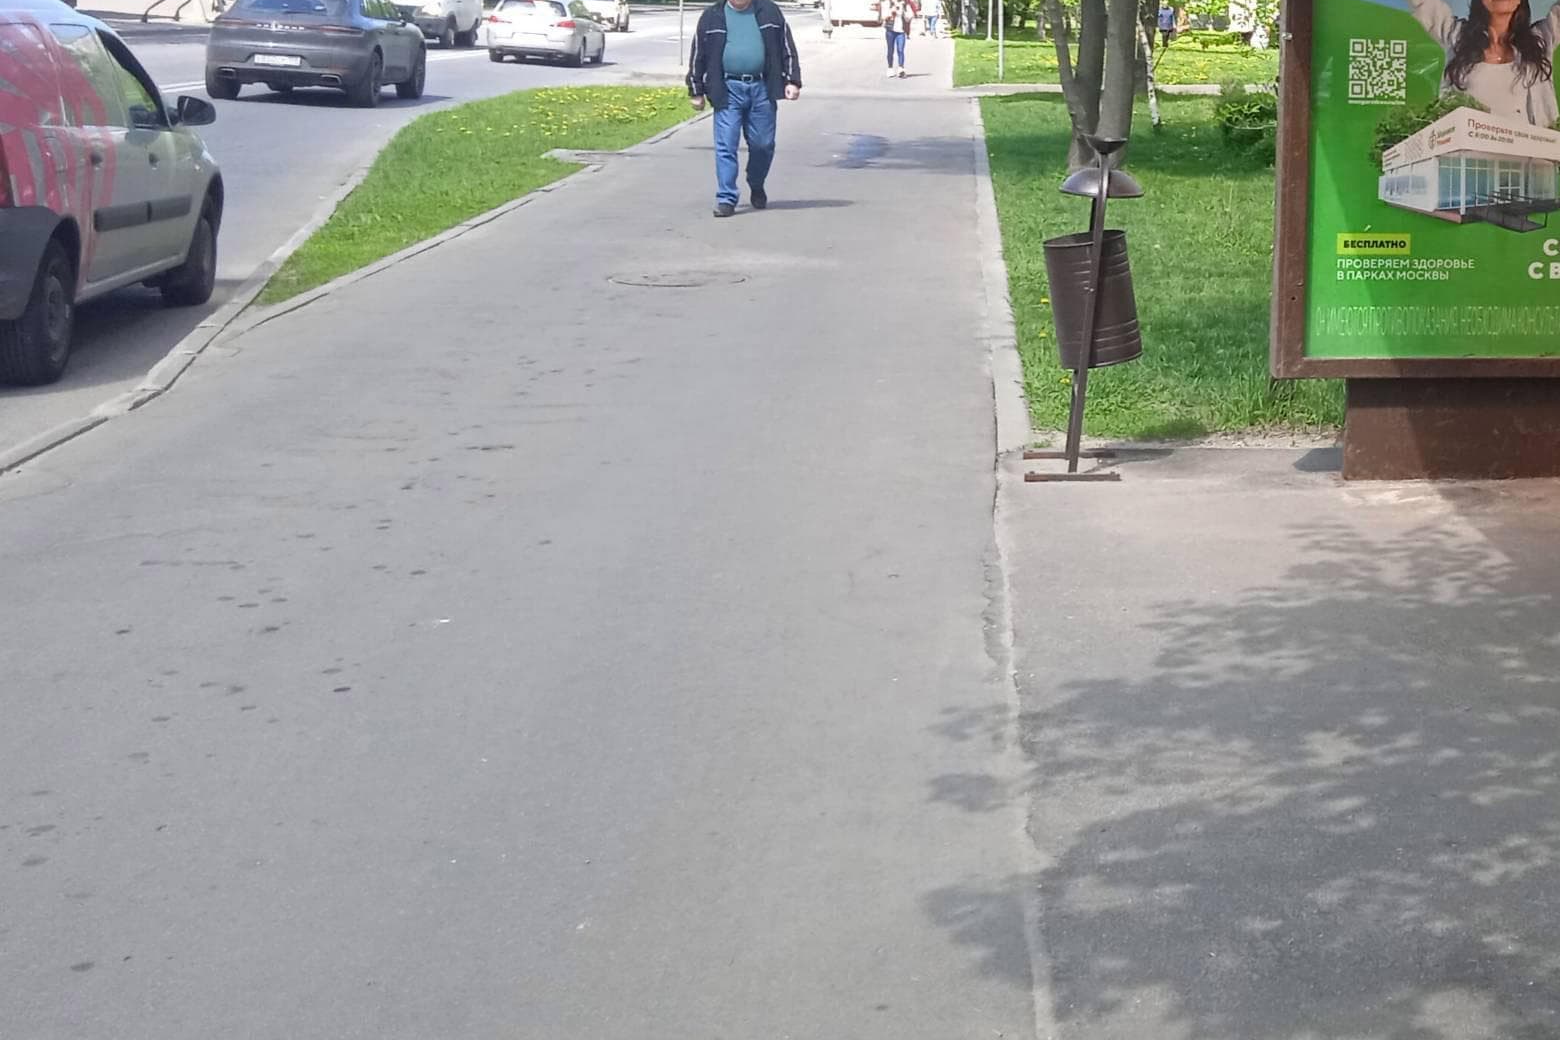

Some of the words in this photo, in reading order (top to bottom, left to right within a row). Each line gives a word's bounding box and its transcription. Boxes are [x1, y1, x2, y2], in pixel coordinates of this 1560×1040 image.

[1343, 240, 1407, 249] БЕСПЛАТНО
[1336, 258, 1410, 269] ПРОВЕРЯЕМ
[1413, 259, 1475, 270] ЗДОРОВЬЕ
[1336, 271, 1344, 280] В
[1346, 270, 1394, 281] ПАРКАХ
[1396, 270, 1449, 281] МОСКВЫ
[1528, 262, 1544, 279] С
